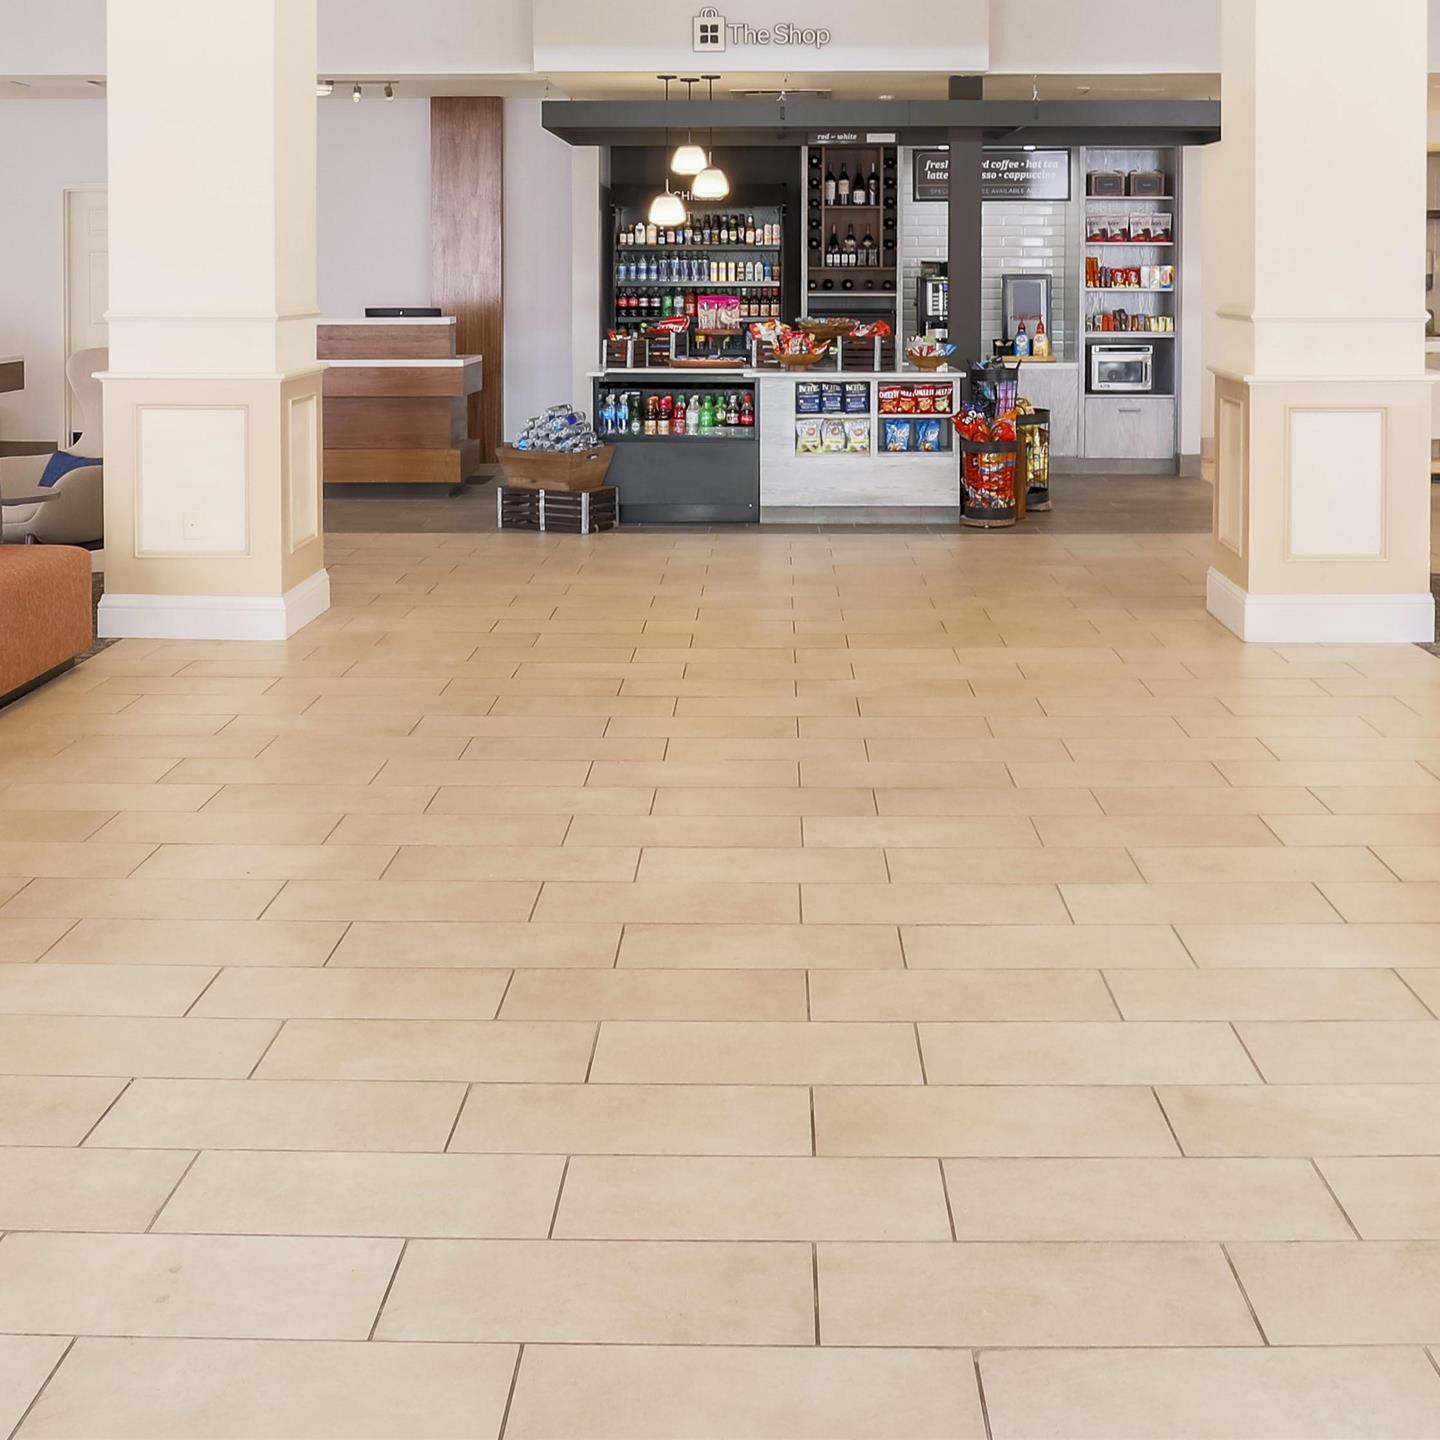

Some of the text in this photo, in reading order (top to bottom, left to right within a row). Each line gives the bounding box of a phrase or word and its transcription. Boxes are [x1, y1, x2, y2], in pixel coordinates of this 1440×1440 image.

[727, 22, 831, 49] The Shop
[990, 160, 1020, 171] coffee
[1025, 160, 1042, 169] hot
[1042, 161, 1058, 169] tea
[926, 170, 949, 180] latte
[1003, 170, 1057, 181] cappuccino
